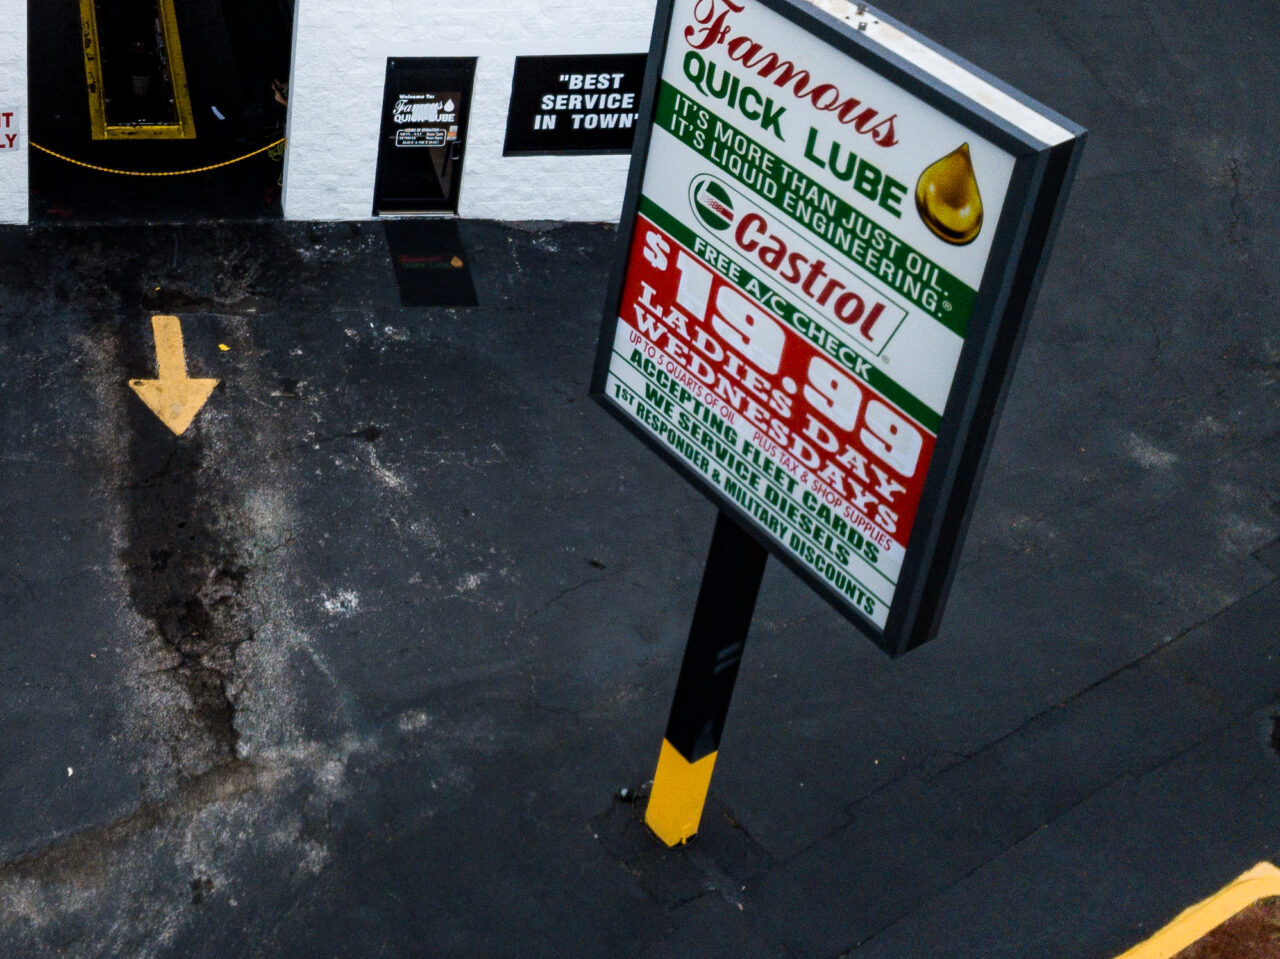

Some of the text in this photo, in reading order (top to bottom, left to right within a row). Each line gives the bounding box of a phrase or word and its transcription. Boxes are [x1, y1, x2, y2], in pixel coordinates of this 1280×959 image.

[394, 114, 424, 123] QUICK
[534, 114, 557, 130] IN
[541, 93, 635, 110] SERVICE
[559, 73, 624, 90] "BEST
[683, 50, 908, 219] QUICK LUBE
[670, 113, 706, 150] IT'S
[710, 141, 777, 199] LIQUID
[674, 94, 949, 297] IT'S MORE THAN JUST OIL.
[694, 237, 872, 381] FREE A/C CHECK
[735, 212, 886, 342] Castrol
[629, 330, 735, 425] UP TO 5 QUARTS OF OIL
[633, 303, 899, 533] WEDNESDAYS
[638, 280, 907, 502] LADIES DAY
[643, 230, 923, 478] $19.99
[614, 383, 876, 616] 1ST RESPONDER & MILITARY DISCOUNTS
[630, 348, 880, 564] ACCEPTING FLEET CARDS
[645, 382, 851, 566] WE SERVICE DIESELS
[752, 431, 893, 551] PLUS TAX & SHOP SUPPLIES
